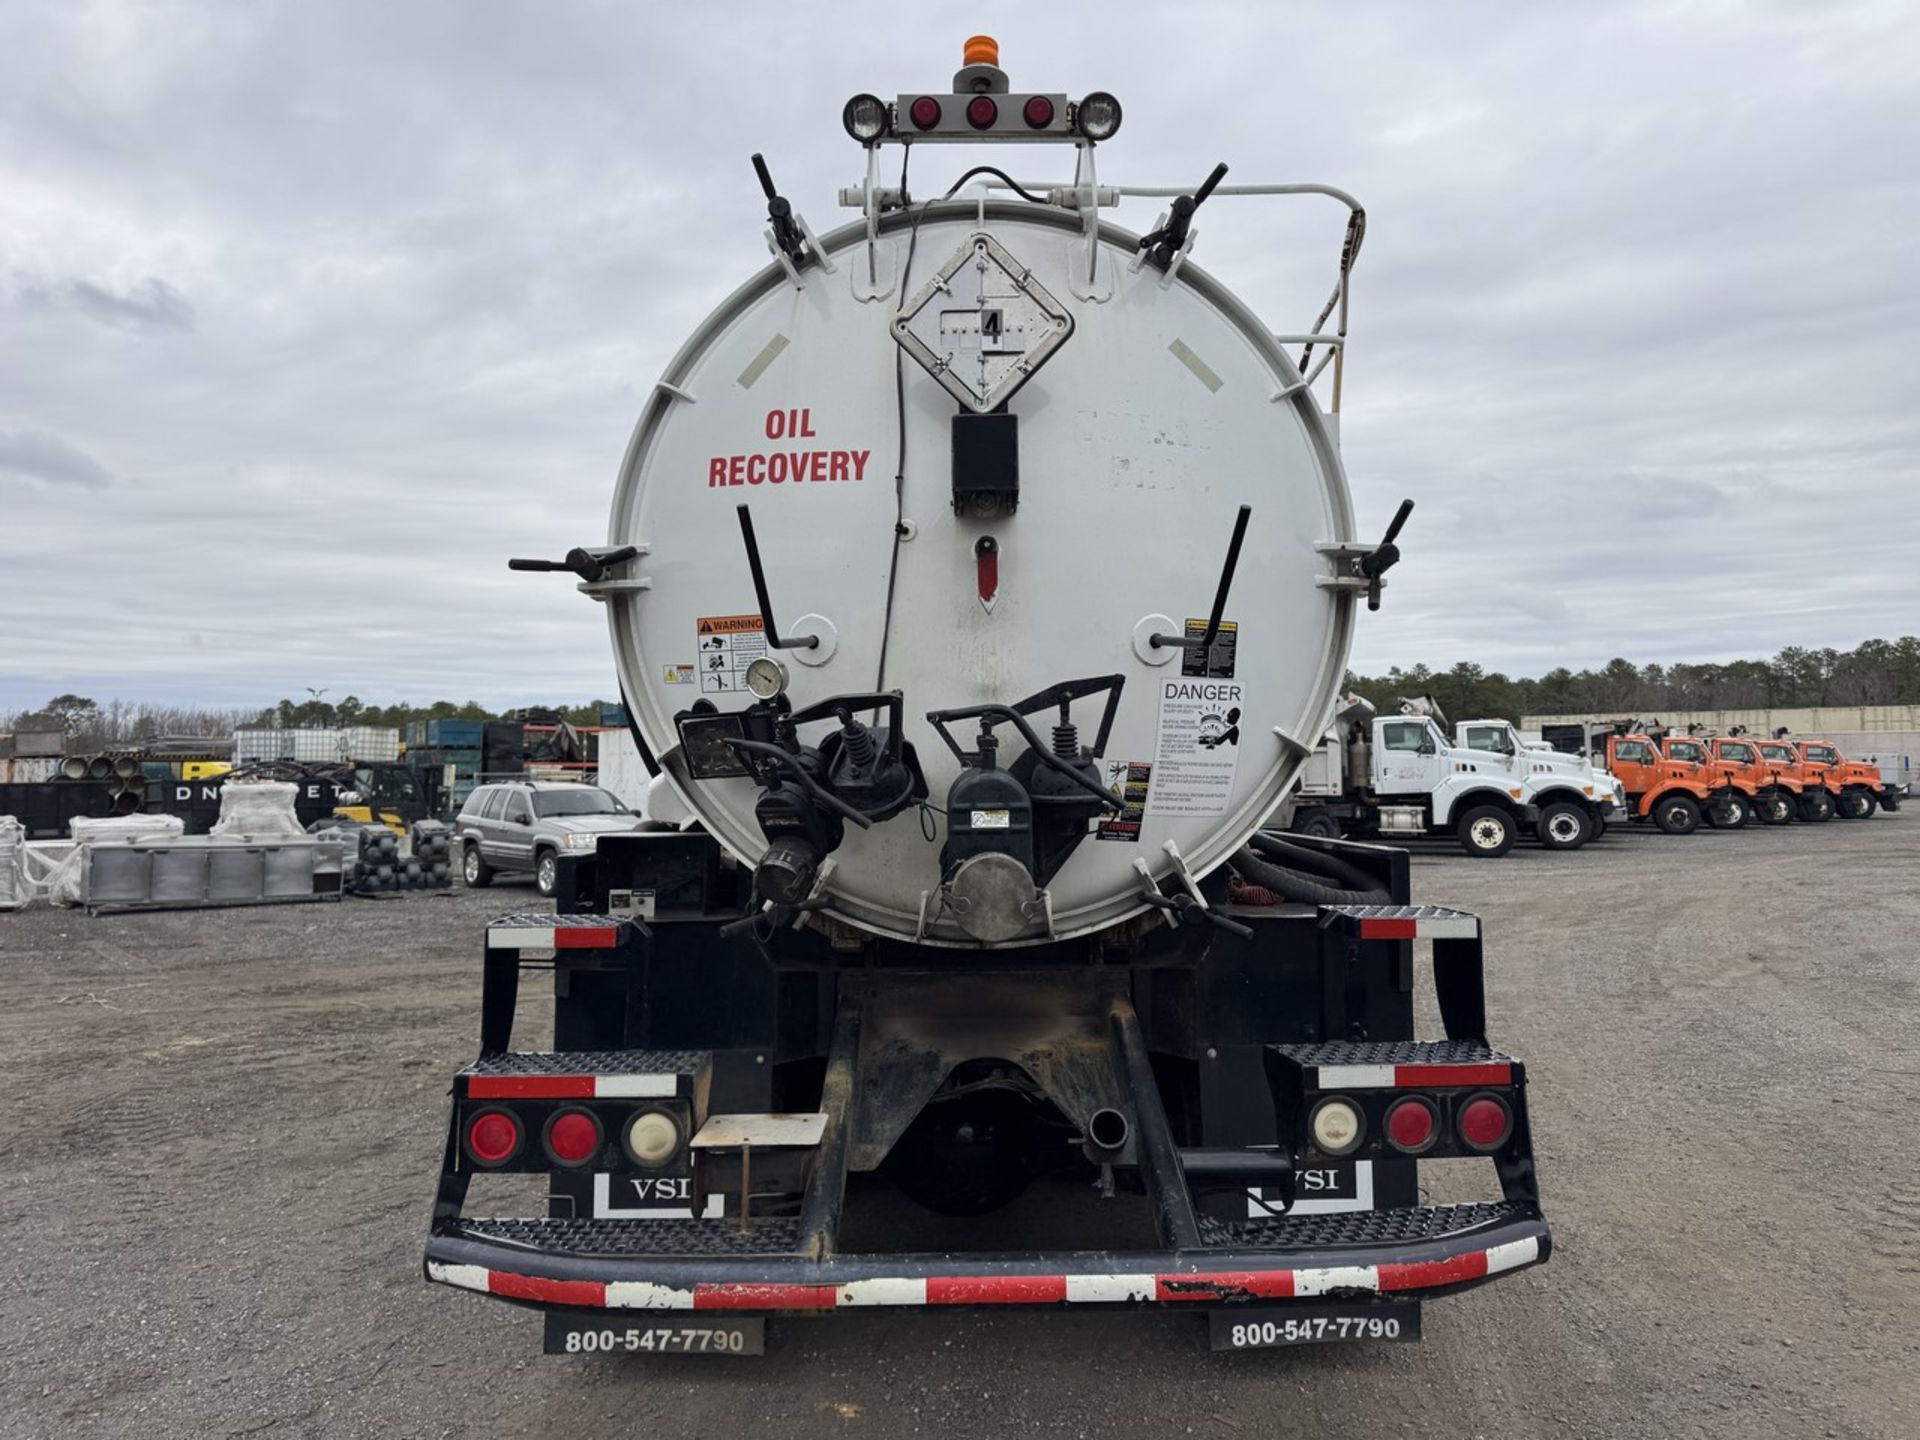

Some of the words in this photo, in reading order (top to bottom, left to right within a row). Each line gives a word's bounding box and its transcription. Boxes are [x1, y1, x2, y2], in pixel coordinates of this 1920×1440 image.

[765, 408, 816, 440] OIL
[708, 450, 871, 488] RECOVERY
[713, 618, 763, 632] WARNING
[1165, 683, 1242, 702] DANGER
[630, 1178, 691, 1200] VSI
[1294, 1169, 1340, 1190] SI
[565, 1329, 744, 1352] 800-547-7790
[1231, 1317, 1400, 1347] 800-547-7790
